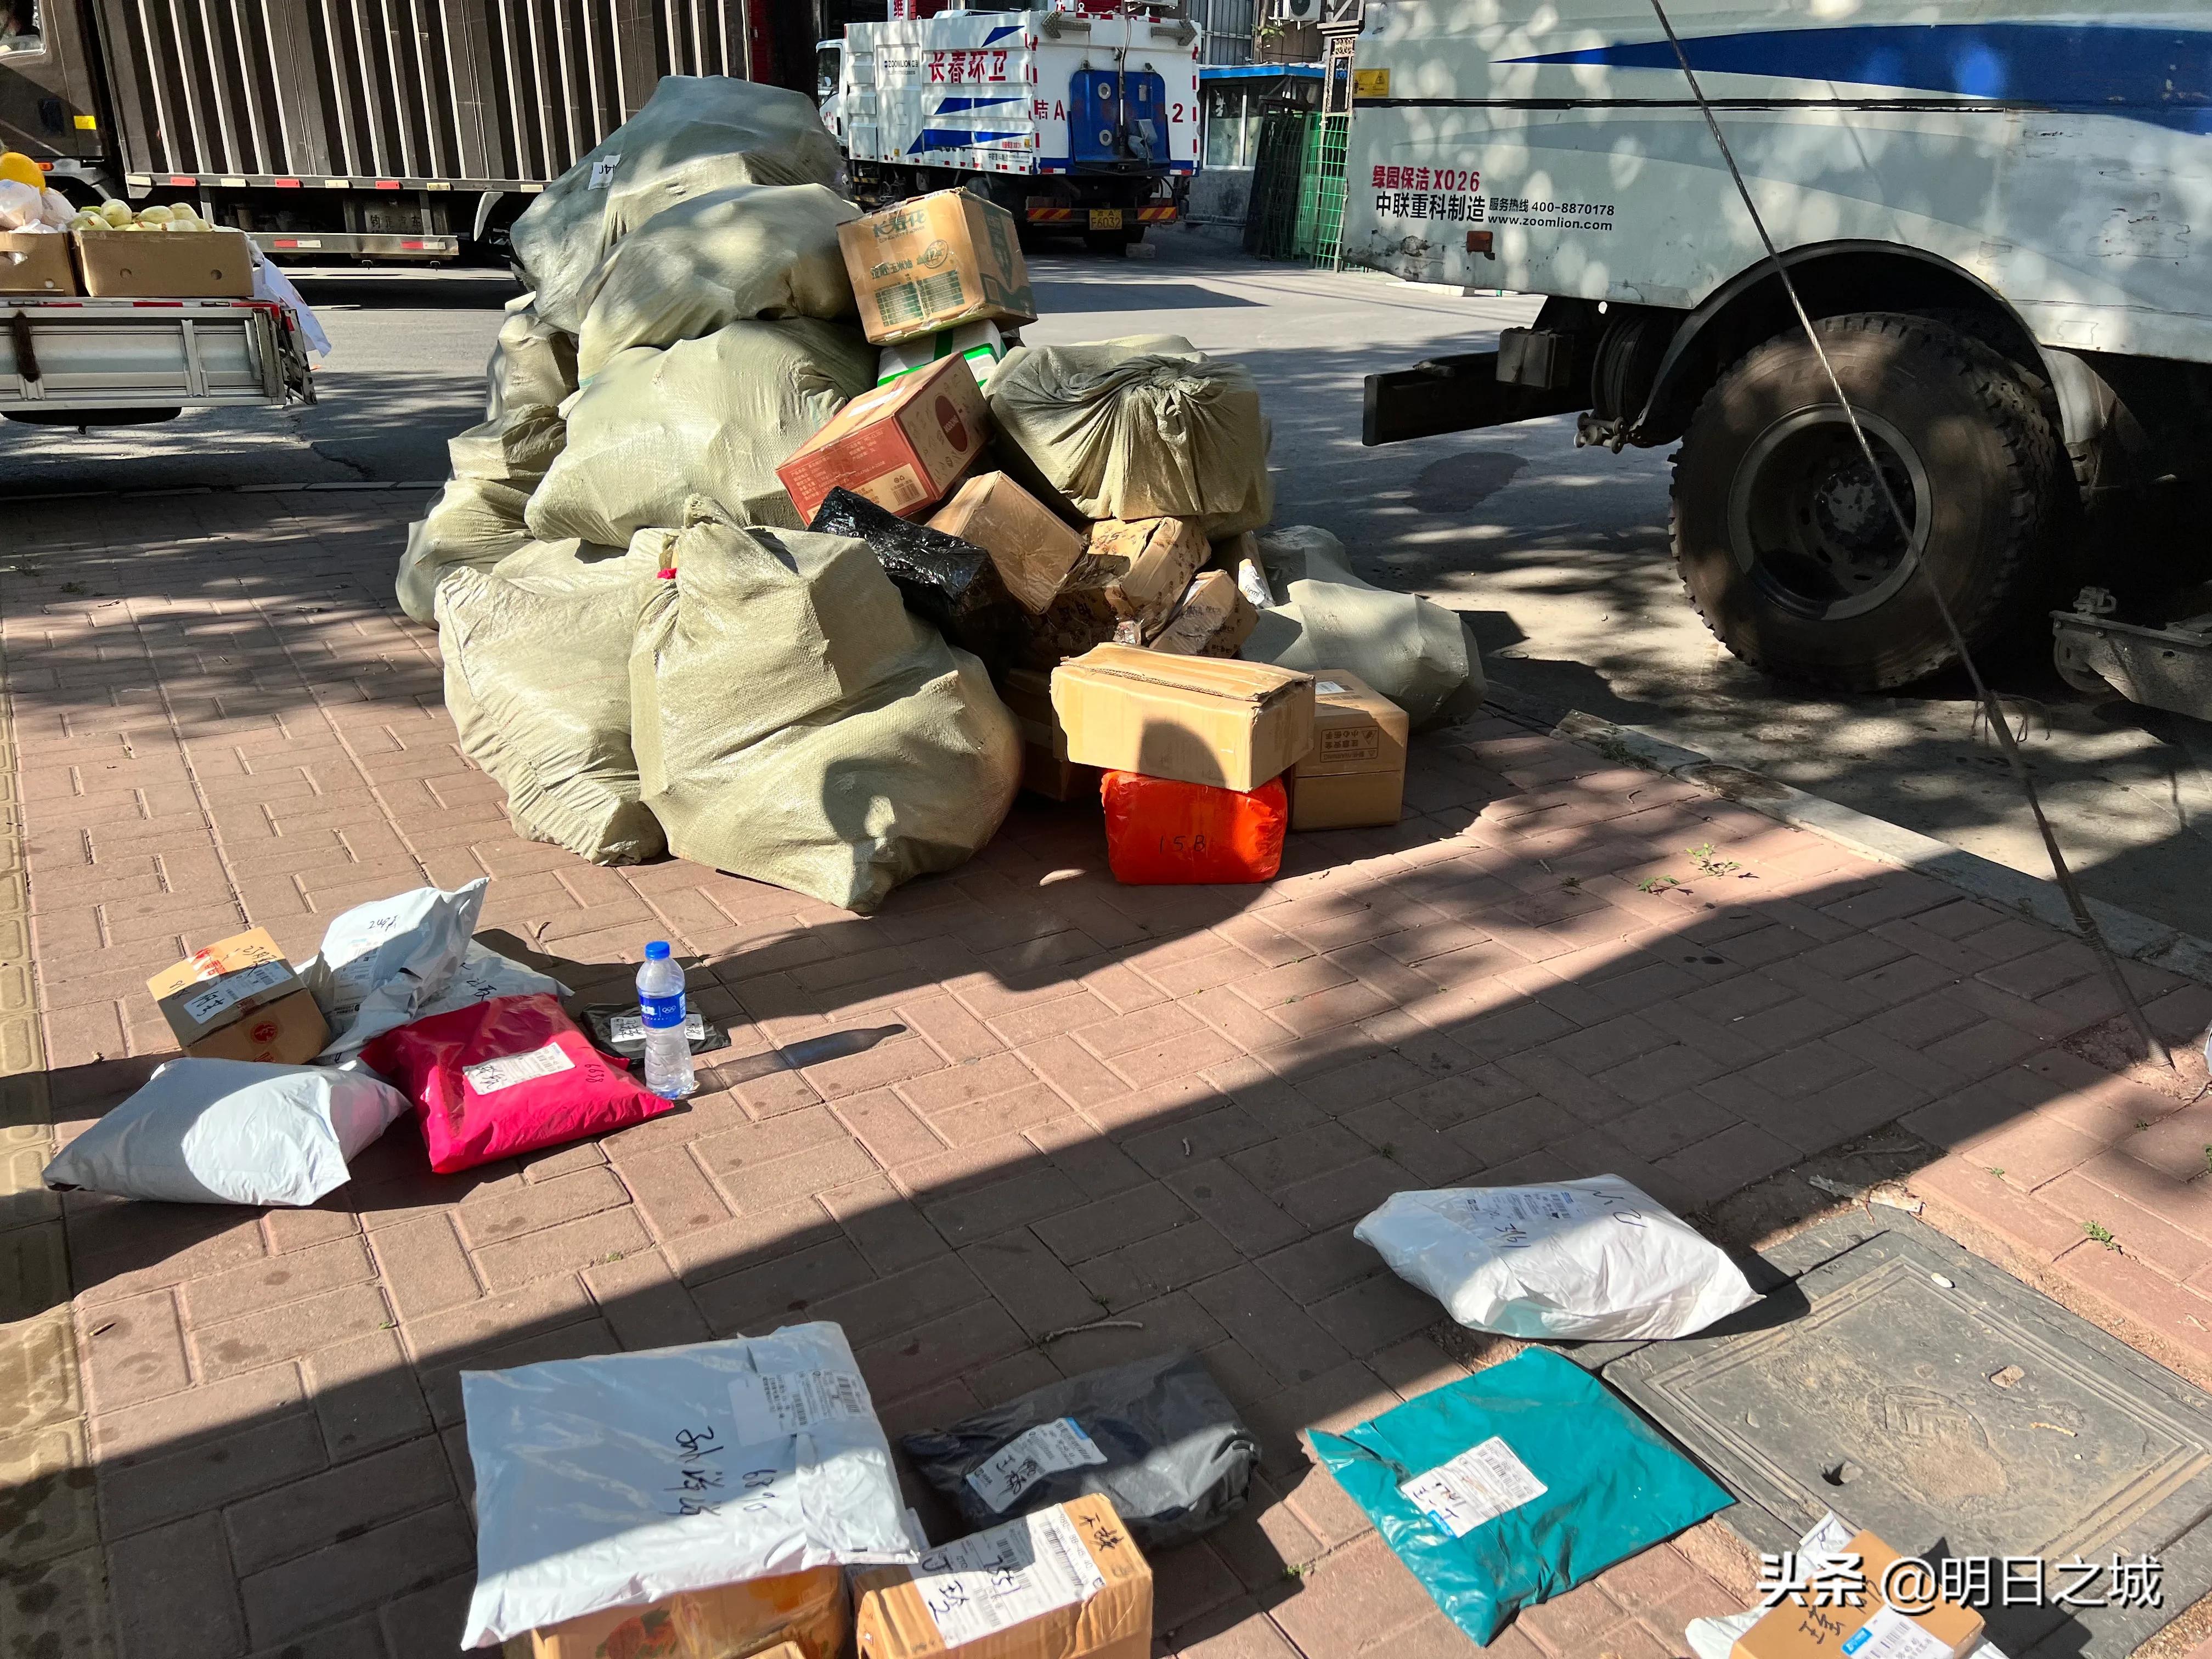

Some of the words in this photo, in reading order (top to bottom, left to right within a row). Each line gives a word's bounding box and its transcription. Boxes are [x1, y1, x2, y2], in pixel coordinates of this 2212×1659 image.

[928, 50, 1007, 83] 长春环卫
[1171, 103, 1184, 123] 2
[1375, 190, 1486, 223] 中联重科制造
[1489, 198, 1529, 213] 服务热线
[1531, 201, 1615, 216] 400-8870178
[1488, 215, 1613, 232] www.zoomlion.com
